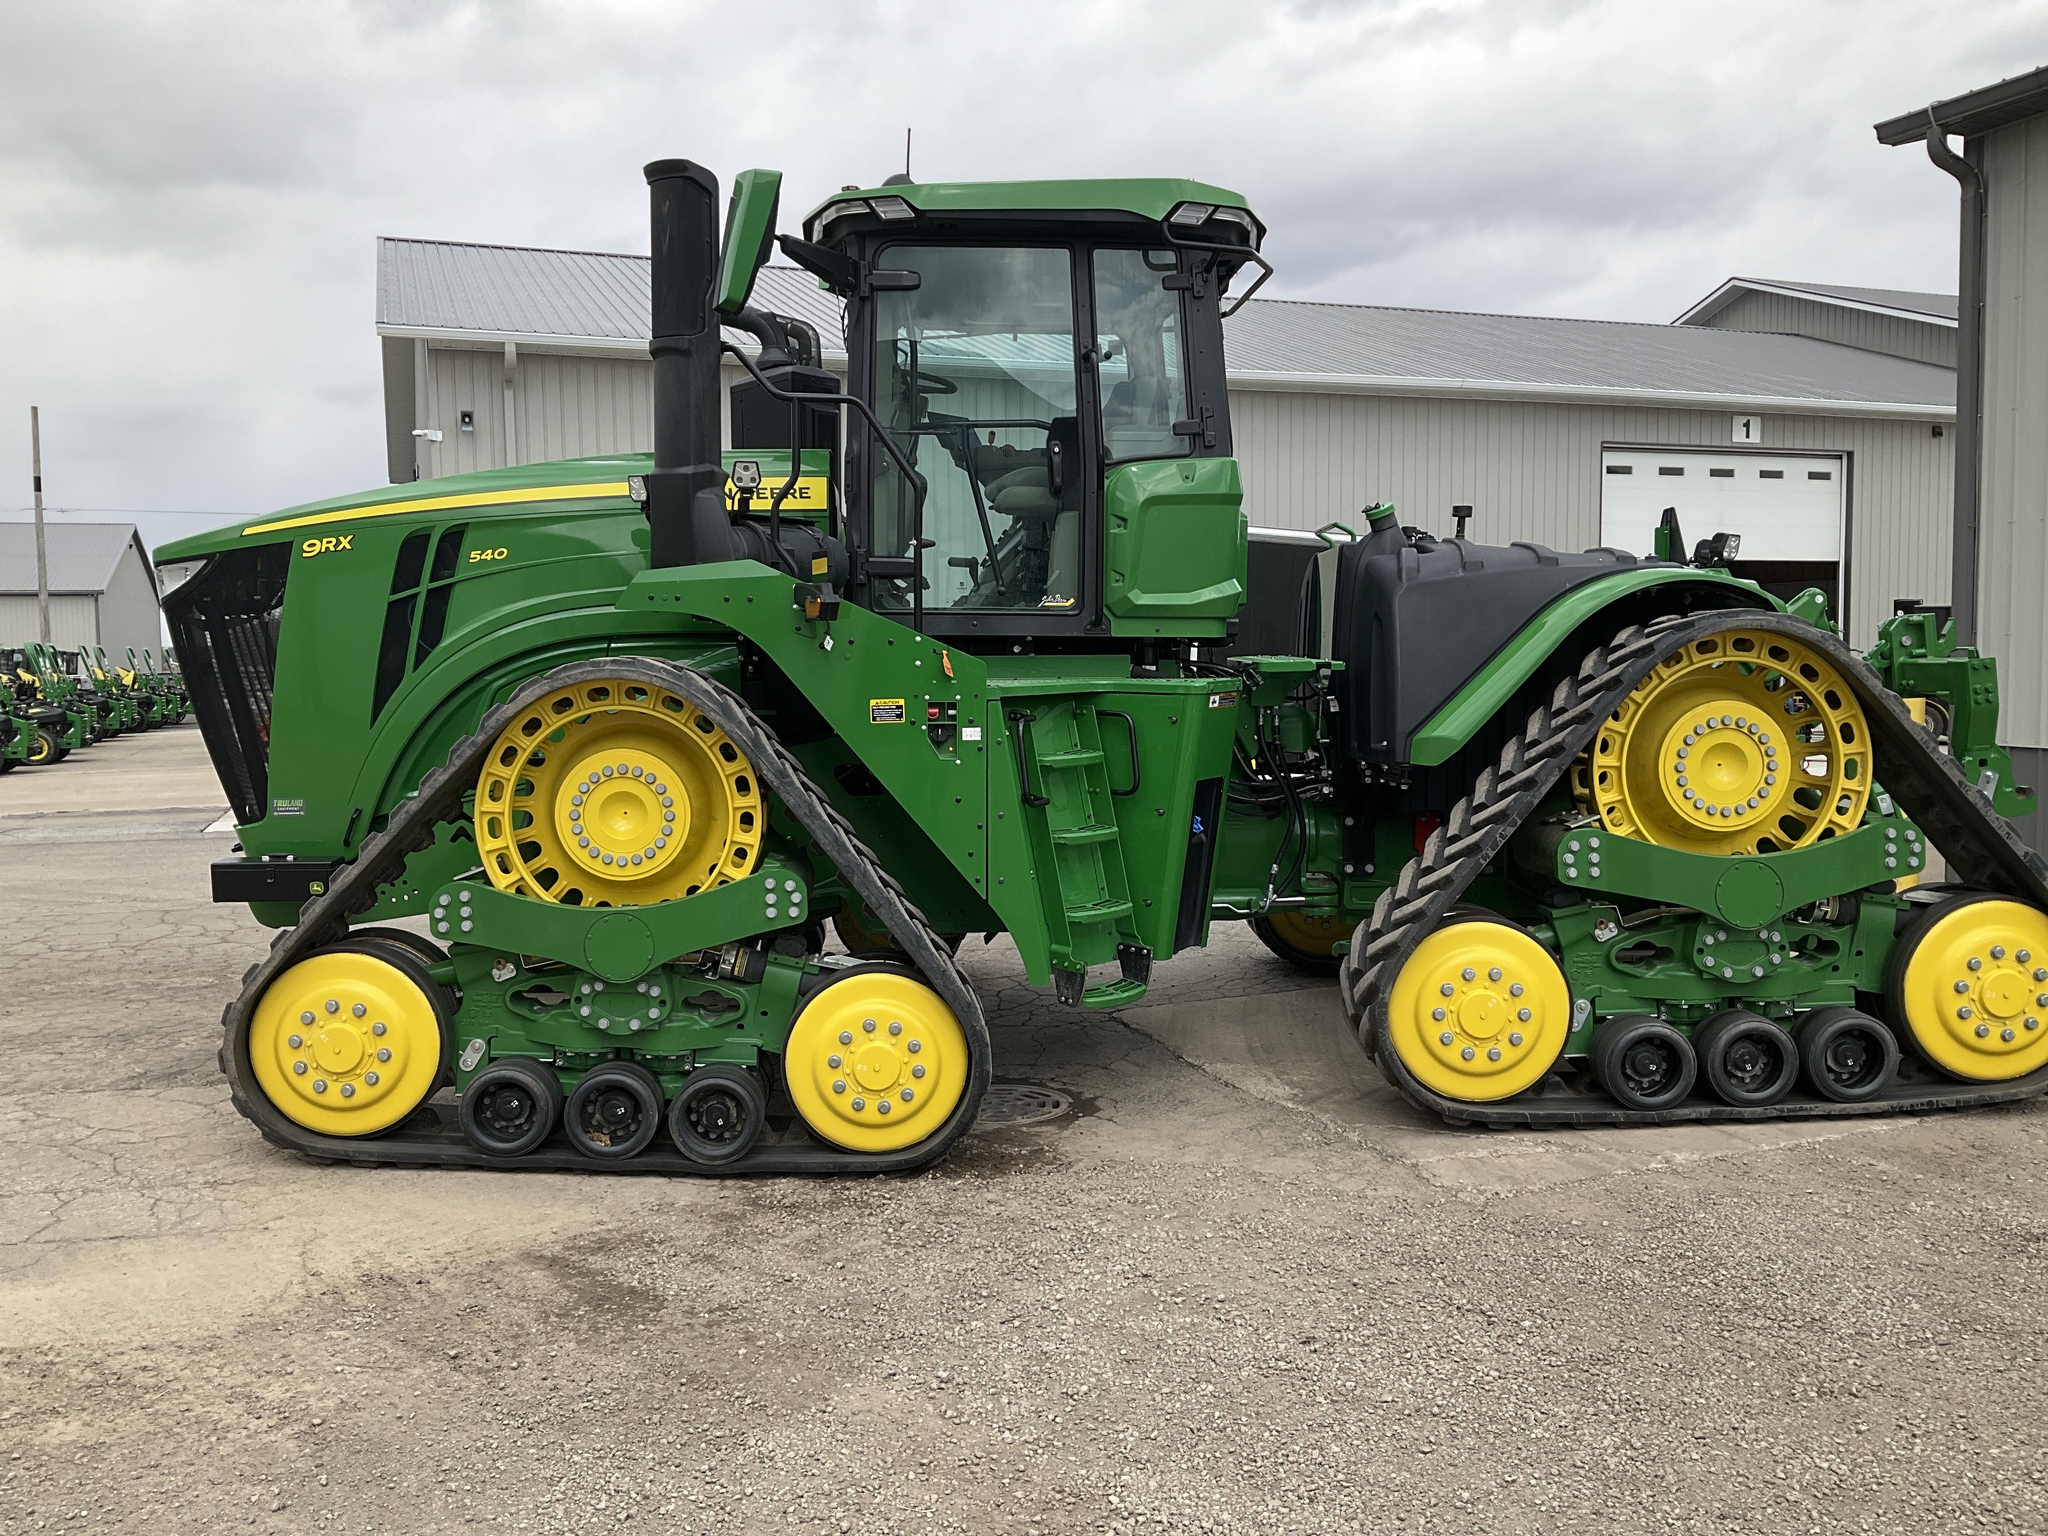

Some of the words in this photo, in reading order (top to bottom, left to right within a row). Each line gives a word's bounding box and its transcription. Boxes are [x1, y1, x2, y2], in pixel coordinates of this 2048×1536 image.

[1743, 419, 1750, 438] 1
[302, 534, 355, 557] 9RX
[469, 547, 508, 563] 540
